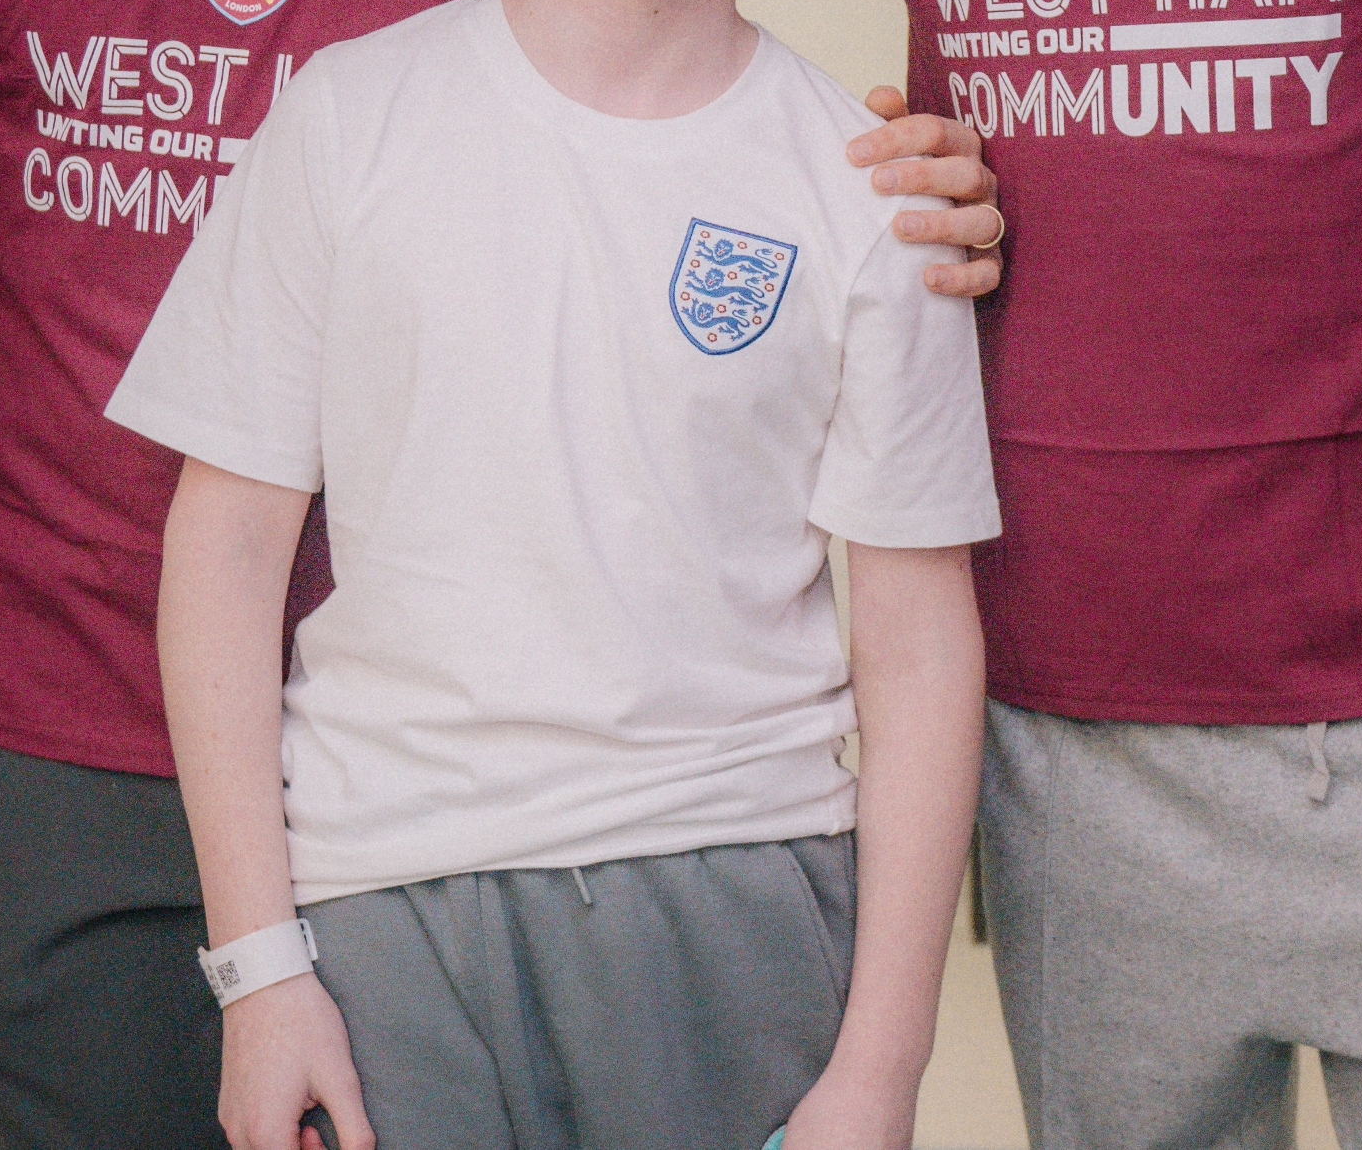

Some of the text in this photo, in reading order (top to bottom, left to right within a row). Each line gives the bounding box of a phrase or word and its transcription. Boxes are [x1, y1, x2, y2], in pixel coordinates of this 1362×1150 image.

[225, 0, 263, 13] LONDON
[937, 26, 1105, 59] UNITING OUR
[26, 30, 250, 126] WEST
[947, 51, 1344, 140] COMMUNITY
[37, 108, 214, 162] UNITING OUR
